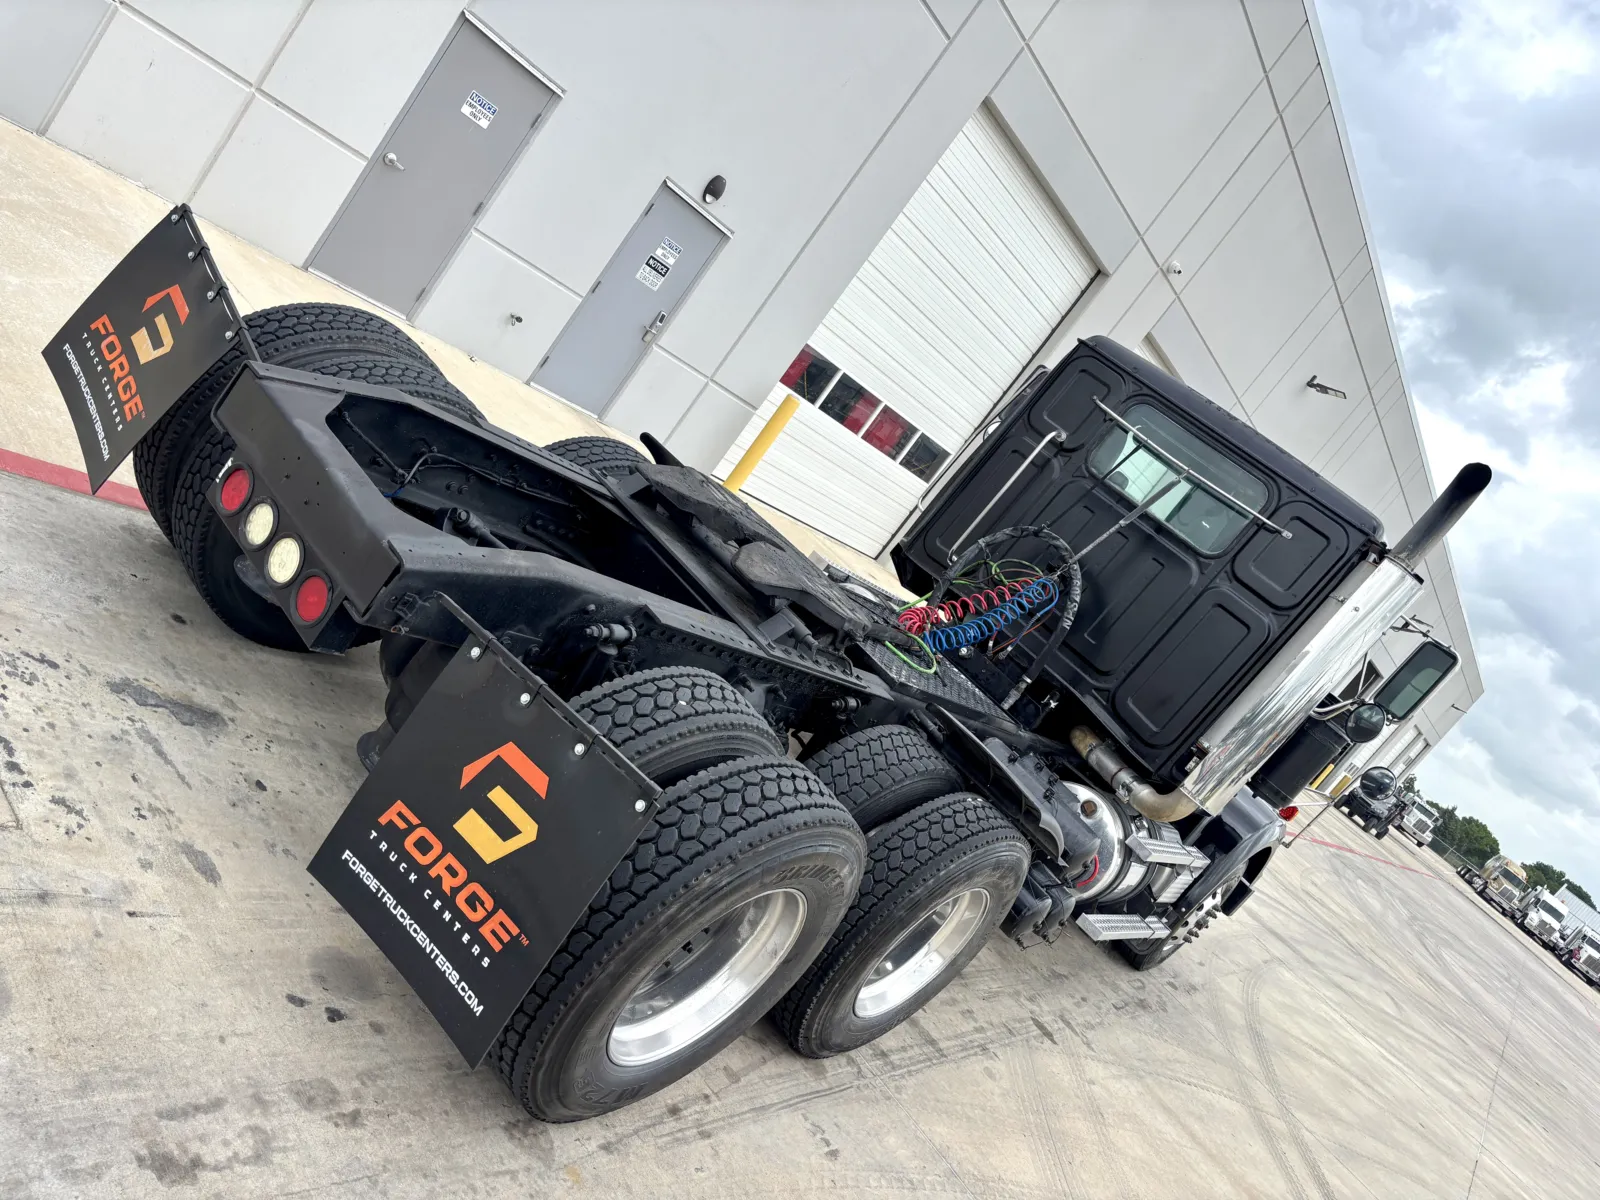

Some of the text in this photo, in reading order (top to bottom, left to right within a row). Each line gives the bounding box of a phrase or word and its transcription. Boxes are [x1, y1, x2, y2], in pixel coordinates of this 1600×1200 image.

[465, 100, 492, 122] EMPLOYEES
[470, 92, 497, 115] NOTICE
[469, 110, 482, 122] ONLY
[663, 237, 682, 255] NOTICE
[647, 257, 668, 275] NOTICE
[82, 332, 123, 432] TRUCK CENTERS
[62, 343, 110, 462] FORGETRUCKCENTERS.COM
[369, 829, 491, 968] TRUCK CENTERS
[341, 849, 484, 1017] FORGETRUCKCENTERS.COM
